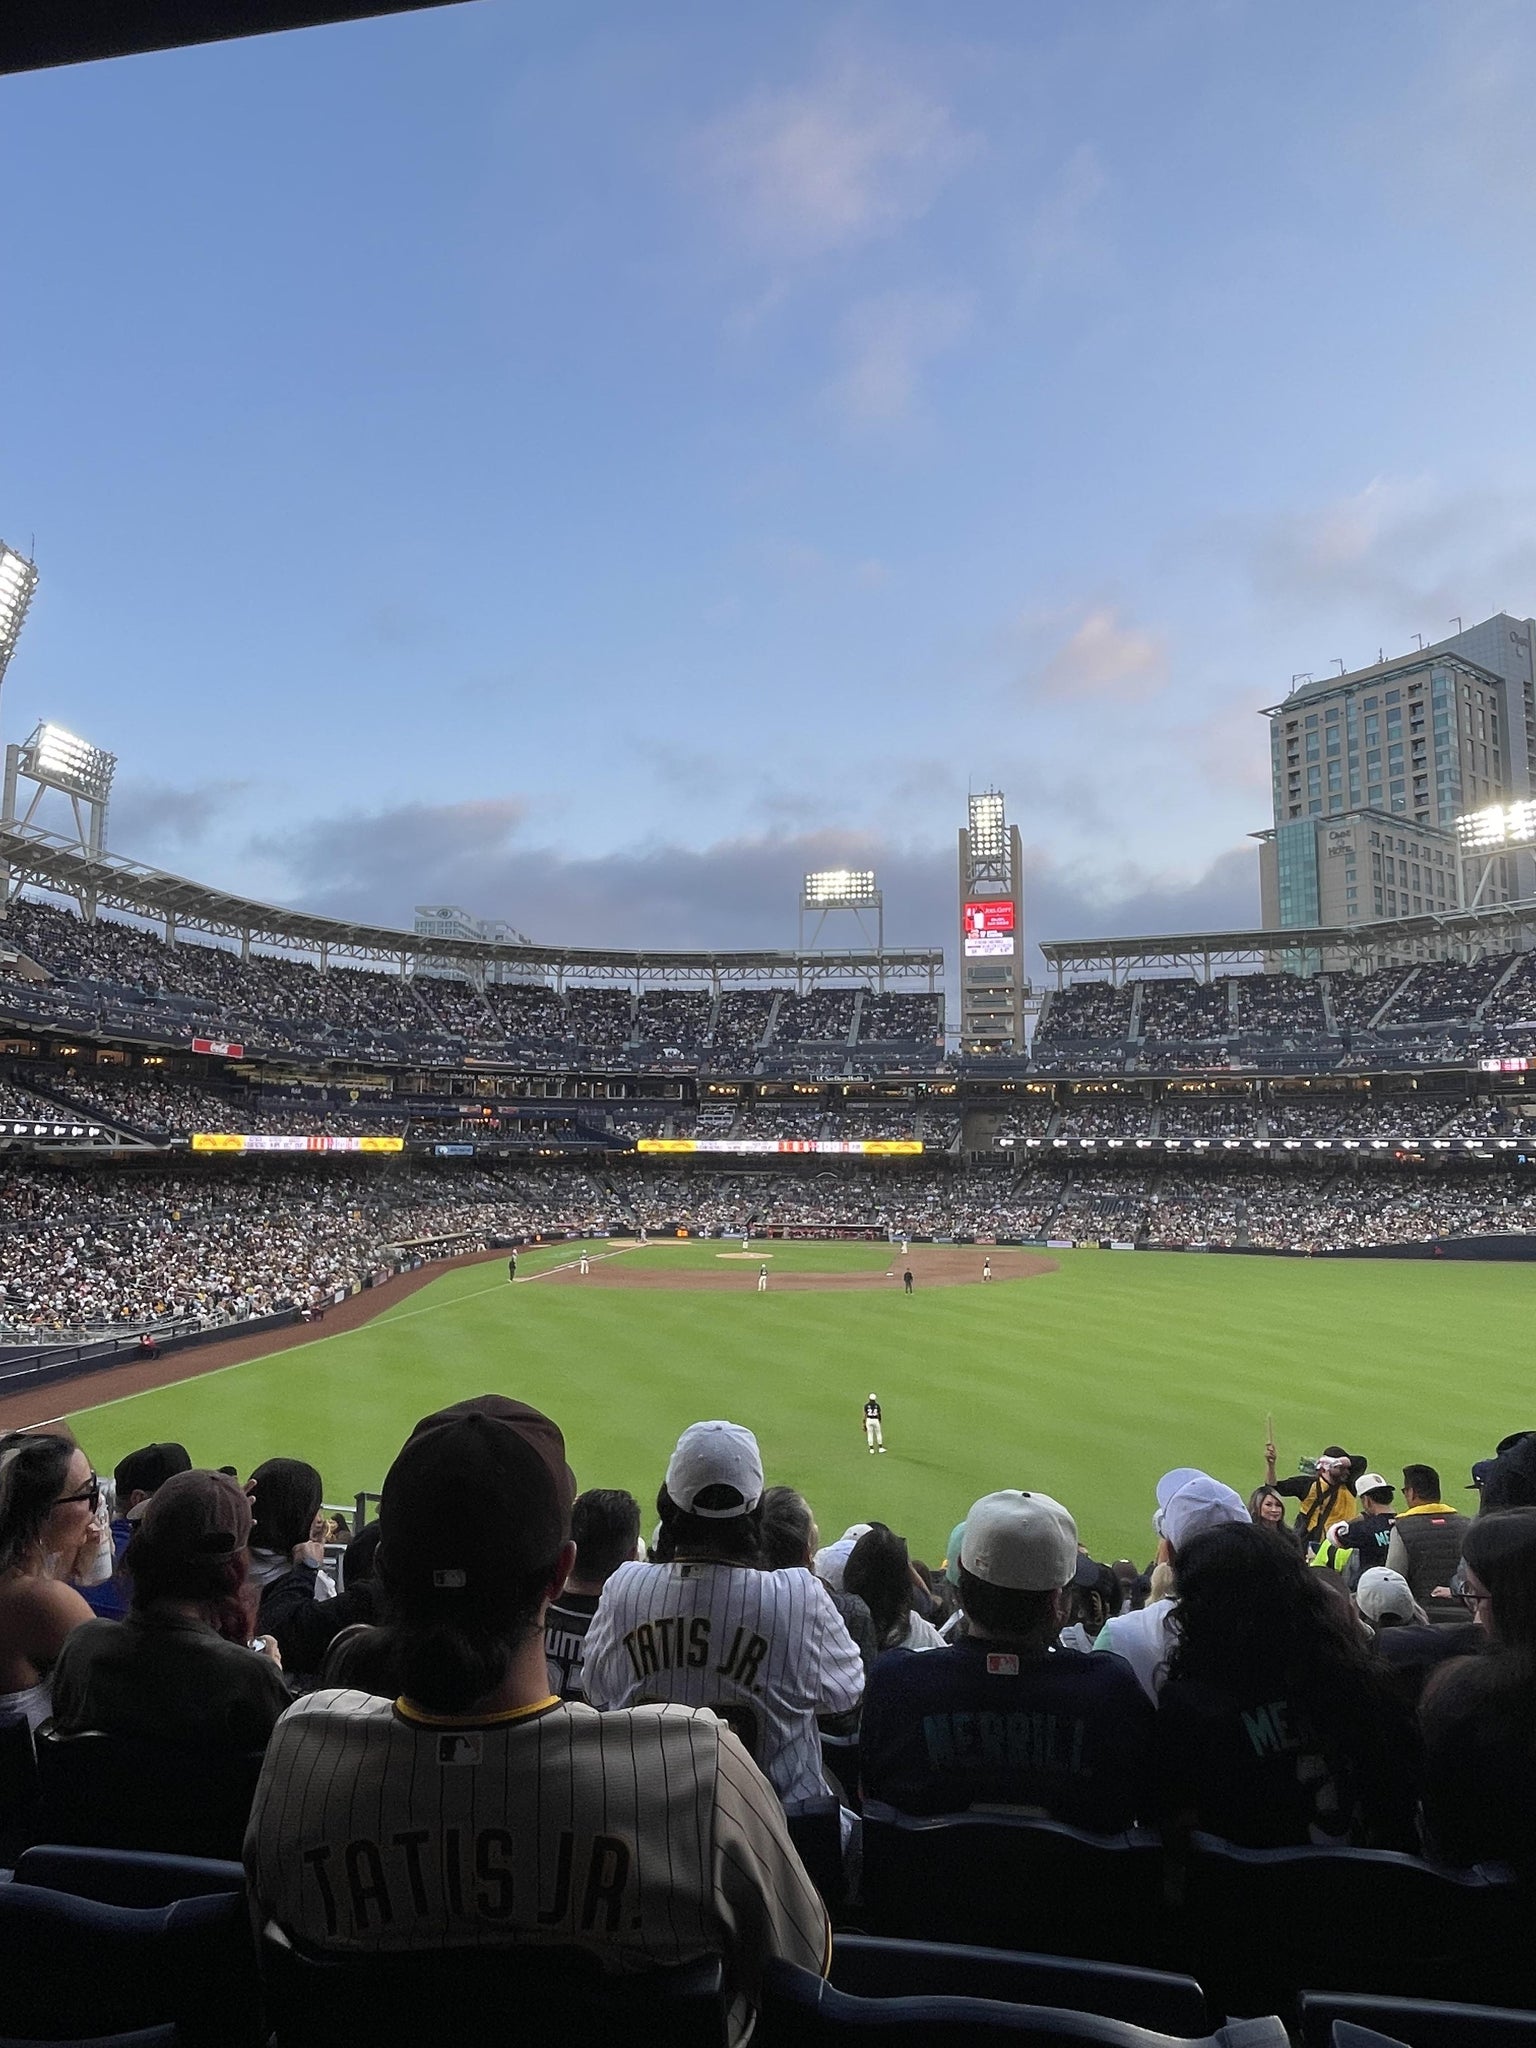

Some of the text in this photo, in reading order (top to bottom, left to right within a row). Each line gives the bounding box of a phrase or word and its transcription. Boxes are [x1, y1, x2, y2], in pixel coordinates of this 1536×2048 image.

[477, 1074, 529, 1082] BROADCAST
[622, 1616, 712, 1681] TATIS
[716, 1625, 771, 1694] JR.
[303, 1828, 642, 1937] TATIS JR.
